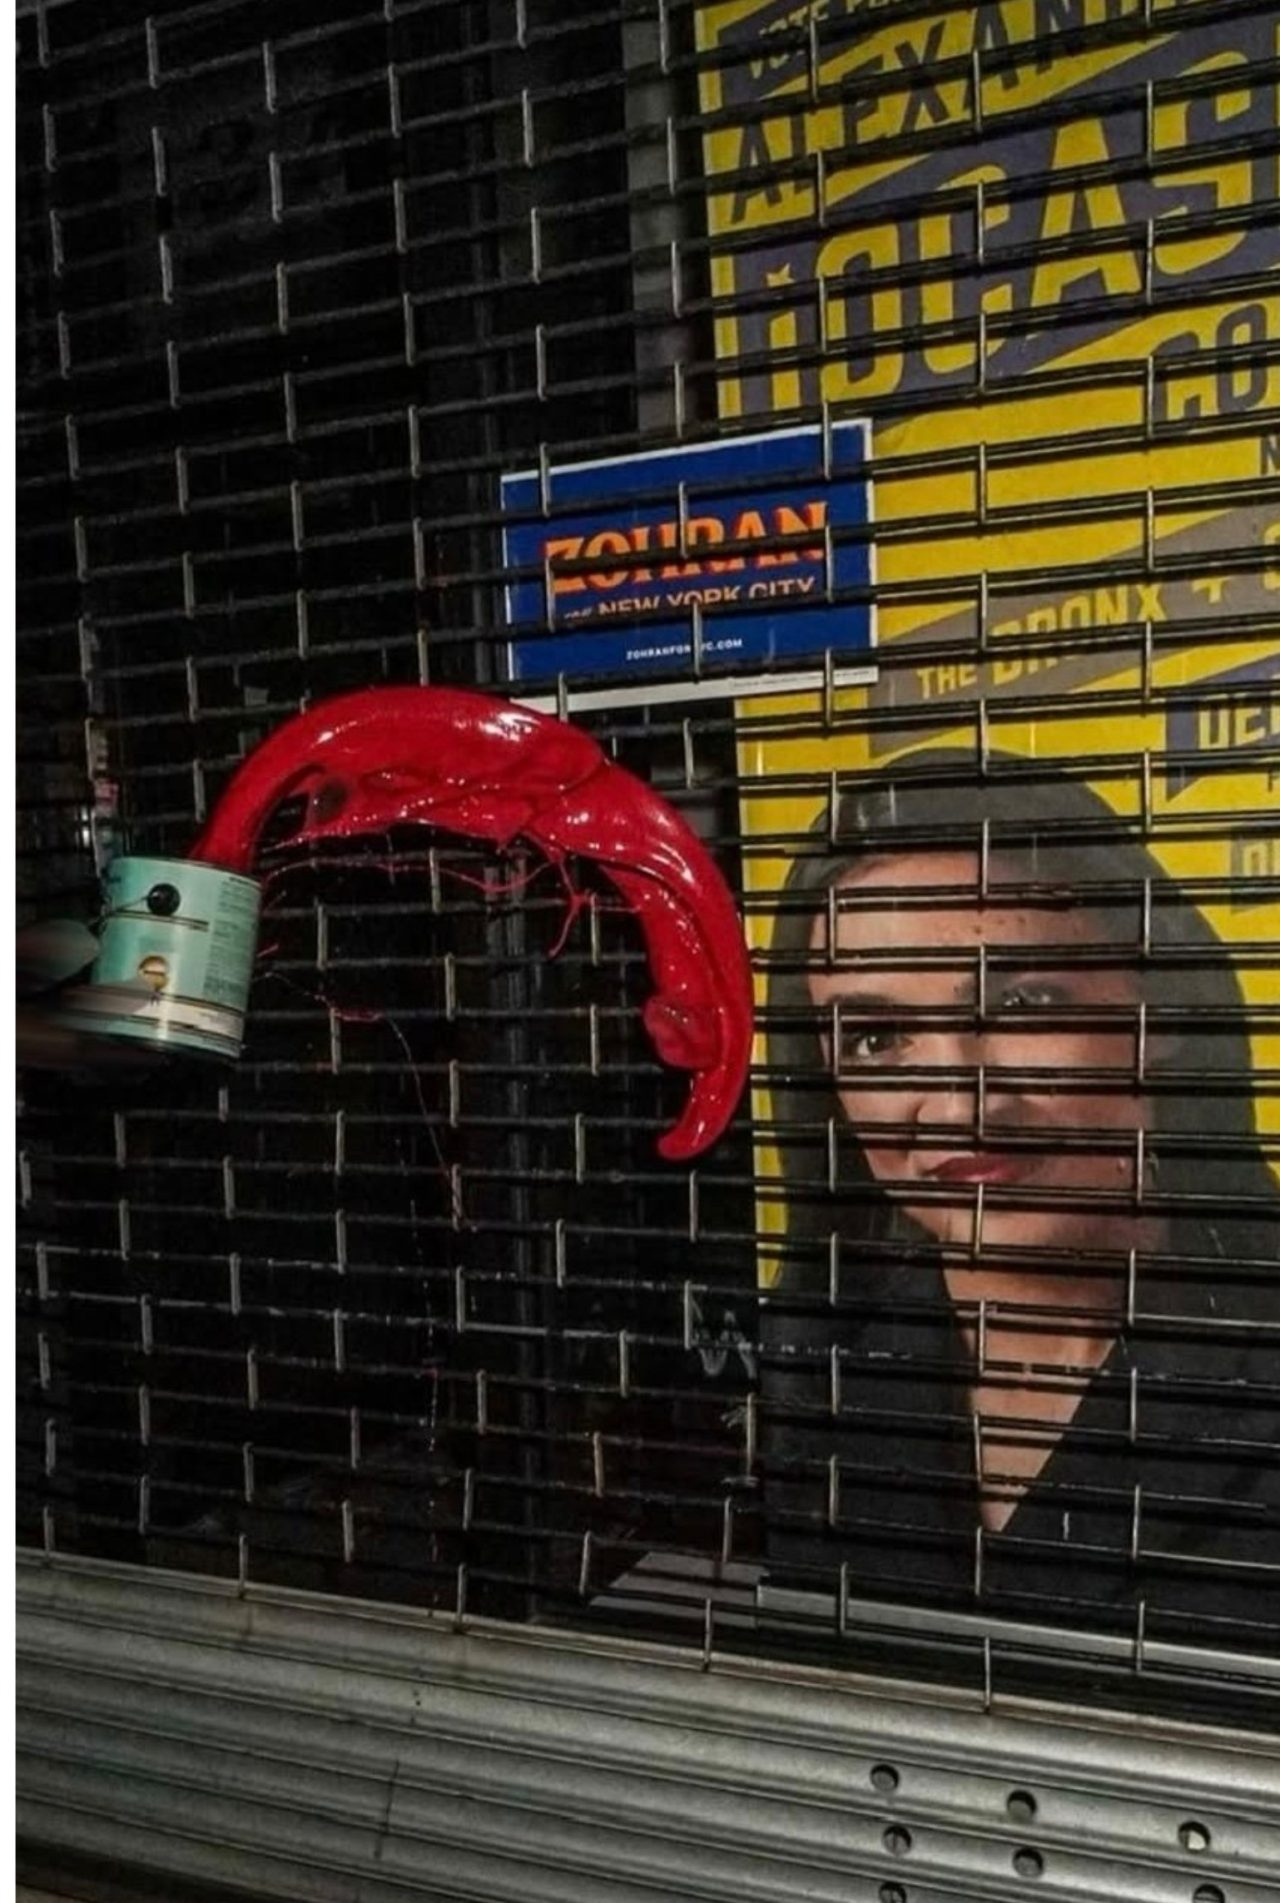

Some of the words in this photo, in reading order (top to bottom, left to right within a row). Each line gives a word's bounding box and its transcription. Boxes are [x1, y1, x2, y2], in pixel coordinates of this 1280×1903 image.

[544, 502, 826, 595] ZOHRAN
[625, 638, 743, 661] ZOHRANFORYC.COM
[917, 660, 977, 699] THE
[991, 582, 1168, 685] BRONX
